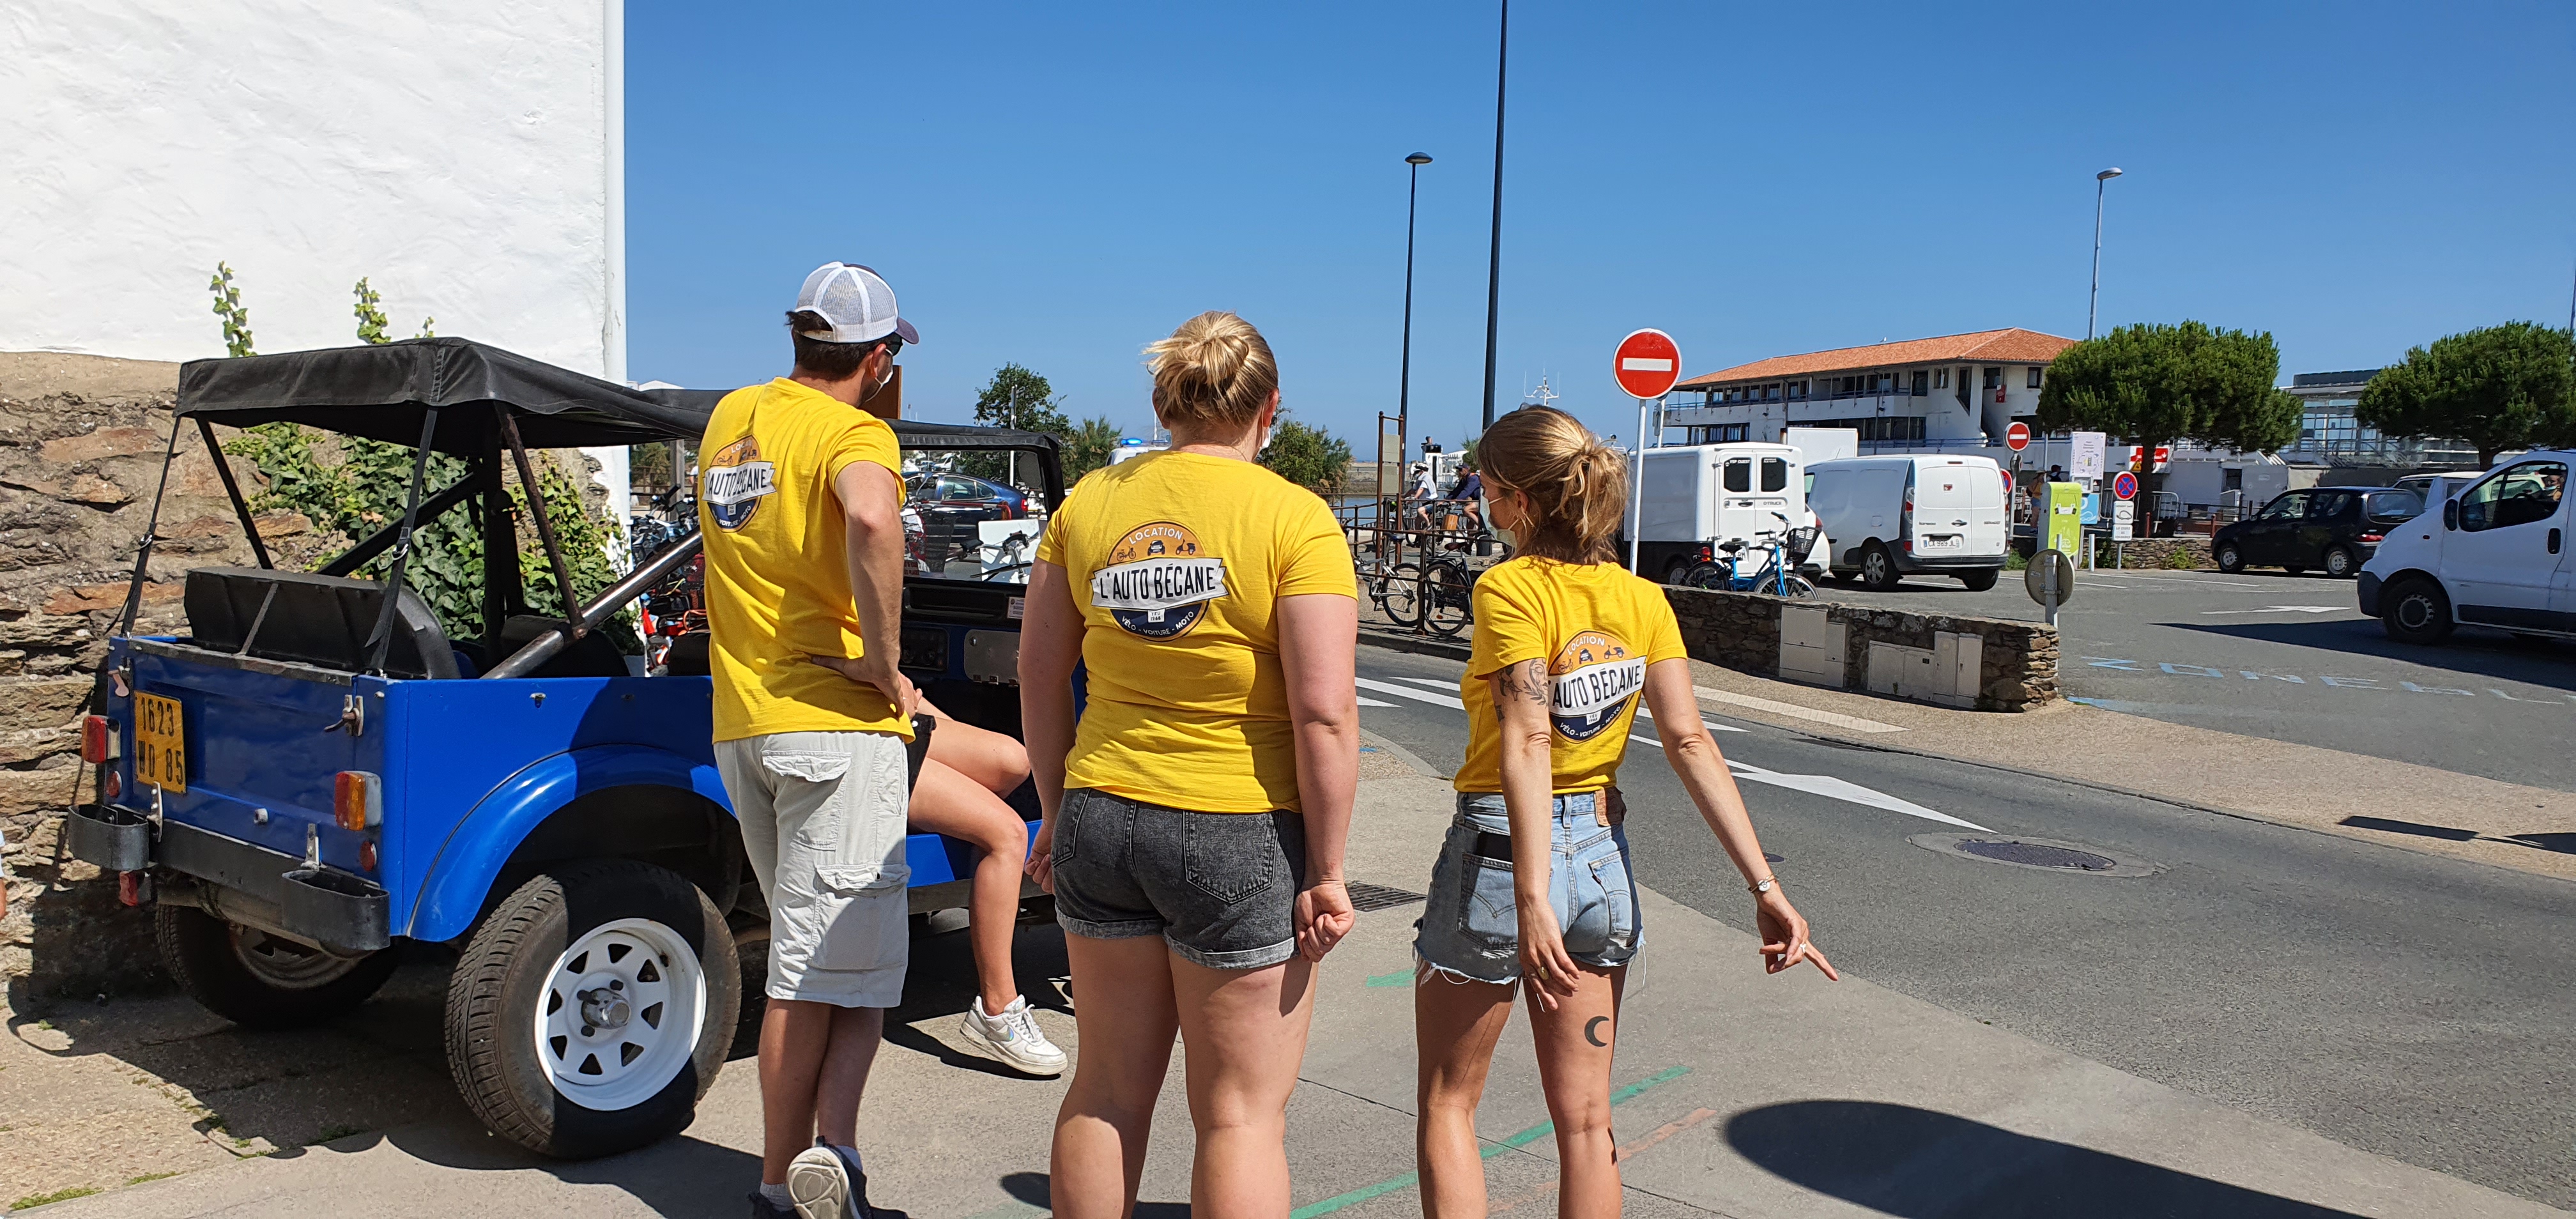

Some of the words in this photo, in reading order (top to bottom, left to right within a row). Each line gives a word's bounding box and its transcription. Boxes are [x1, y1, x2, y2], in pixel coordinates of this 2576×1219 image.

[740, 505, 751, 521] MOTO
[1128, 526, 1183, 545] LOCATION
[1100, 568, 1149, 601] L'AUTO
[1154, 563, 1216, 599] BÉCANE
[1122, 615, 1137, 631] VÉLO
[1176, 611, 1194, 630] MOTO
[1567, 635, 1606, 656] LOCATION
[1548, 676, 1589, 709] 'AUTO
[1588, 665, 1641, 703] BÉCANE
[2080, 656, 2392, 691] ZONE
[141, 696, 174, 737] 1623
[1560, 722, 1575, 735] VÉLO
[1579, 724, 1601, 737] VOITURE
[1605, 706, 1621, 724] MOTO
[165, 747, 183, 785] 85
